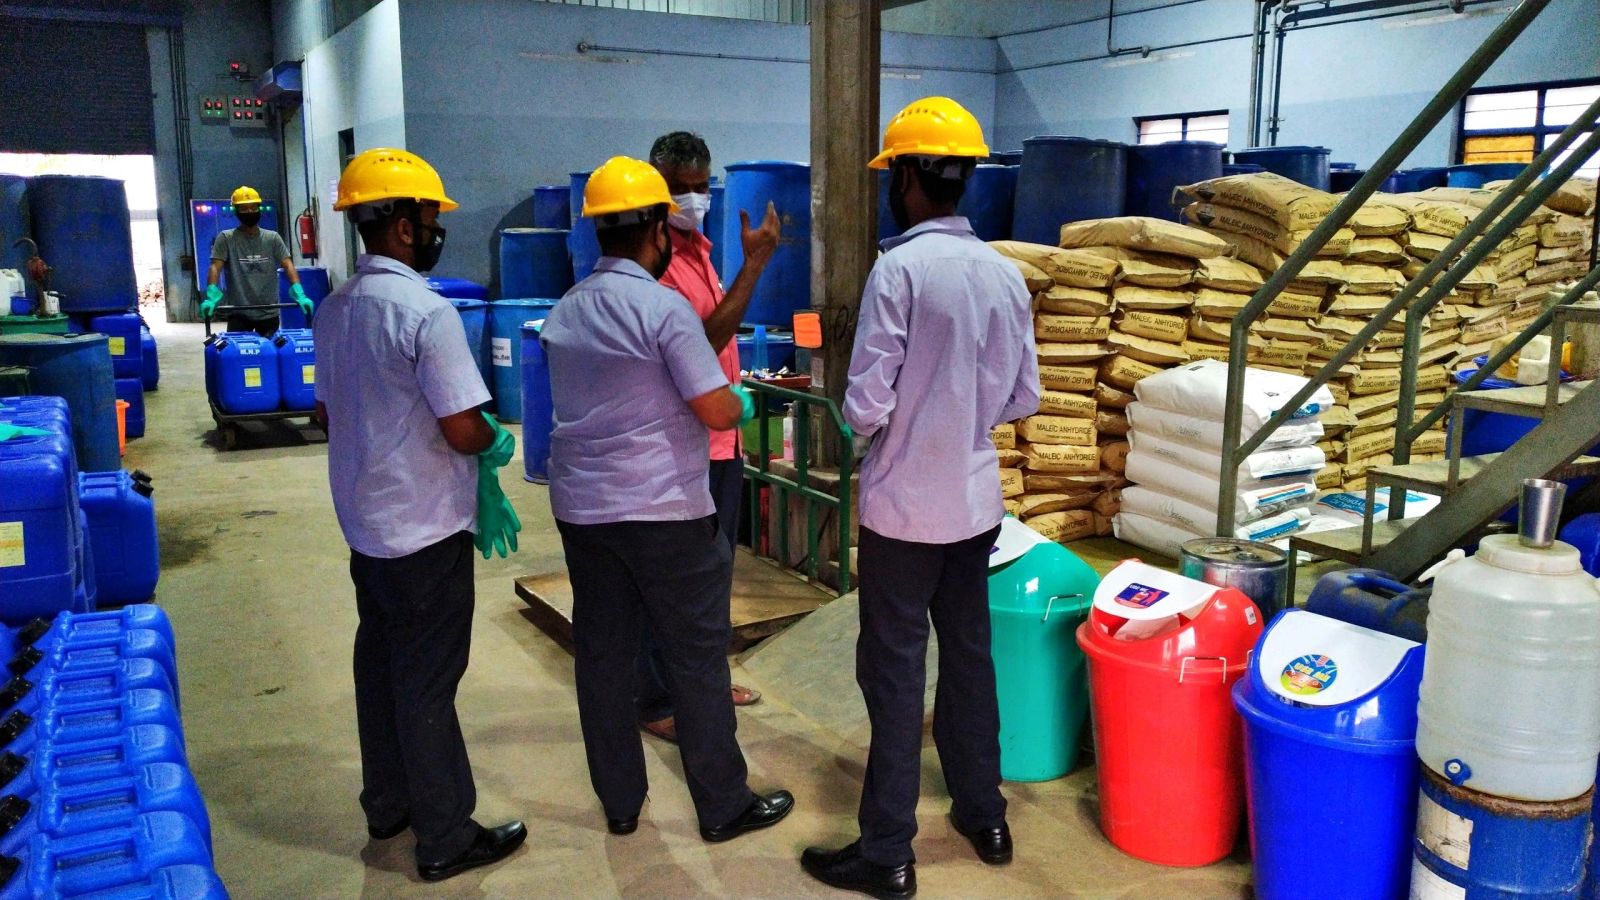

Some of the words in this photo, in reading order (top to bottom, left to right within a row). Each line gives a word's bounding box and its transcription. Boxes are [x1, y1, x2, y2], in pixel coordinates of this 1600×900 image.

[1045, 325, 1083, 334] ANHYDRIDE
[1037, 423, 1059, 432] MALEIC
[1060, 426, 1092, 435] ANHYDRIDE
[1039, 452, 1060, 460] MALEIC
[1063, 453, 1096, 461] ANHYDRIDE
